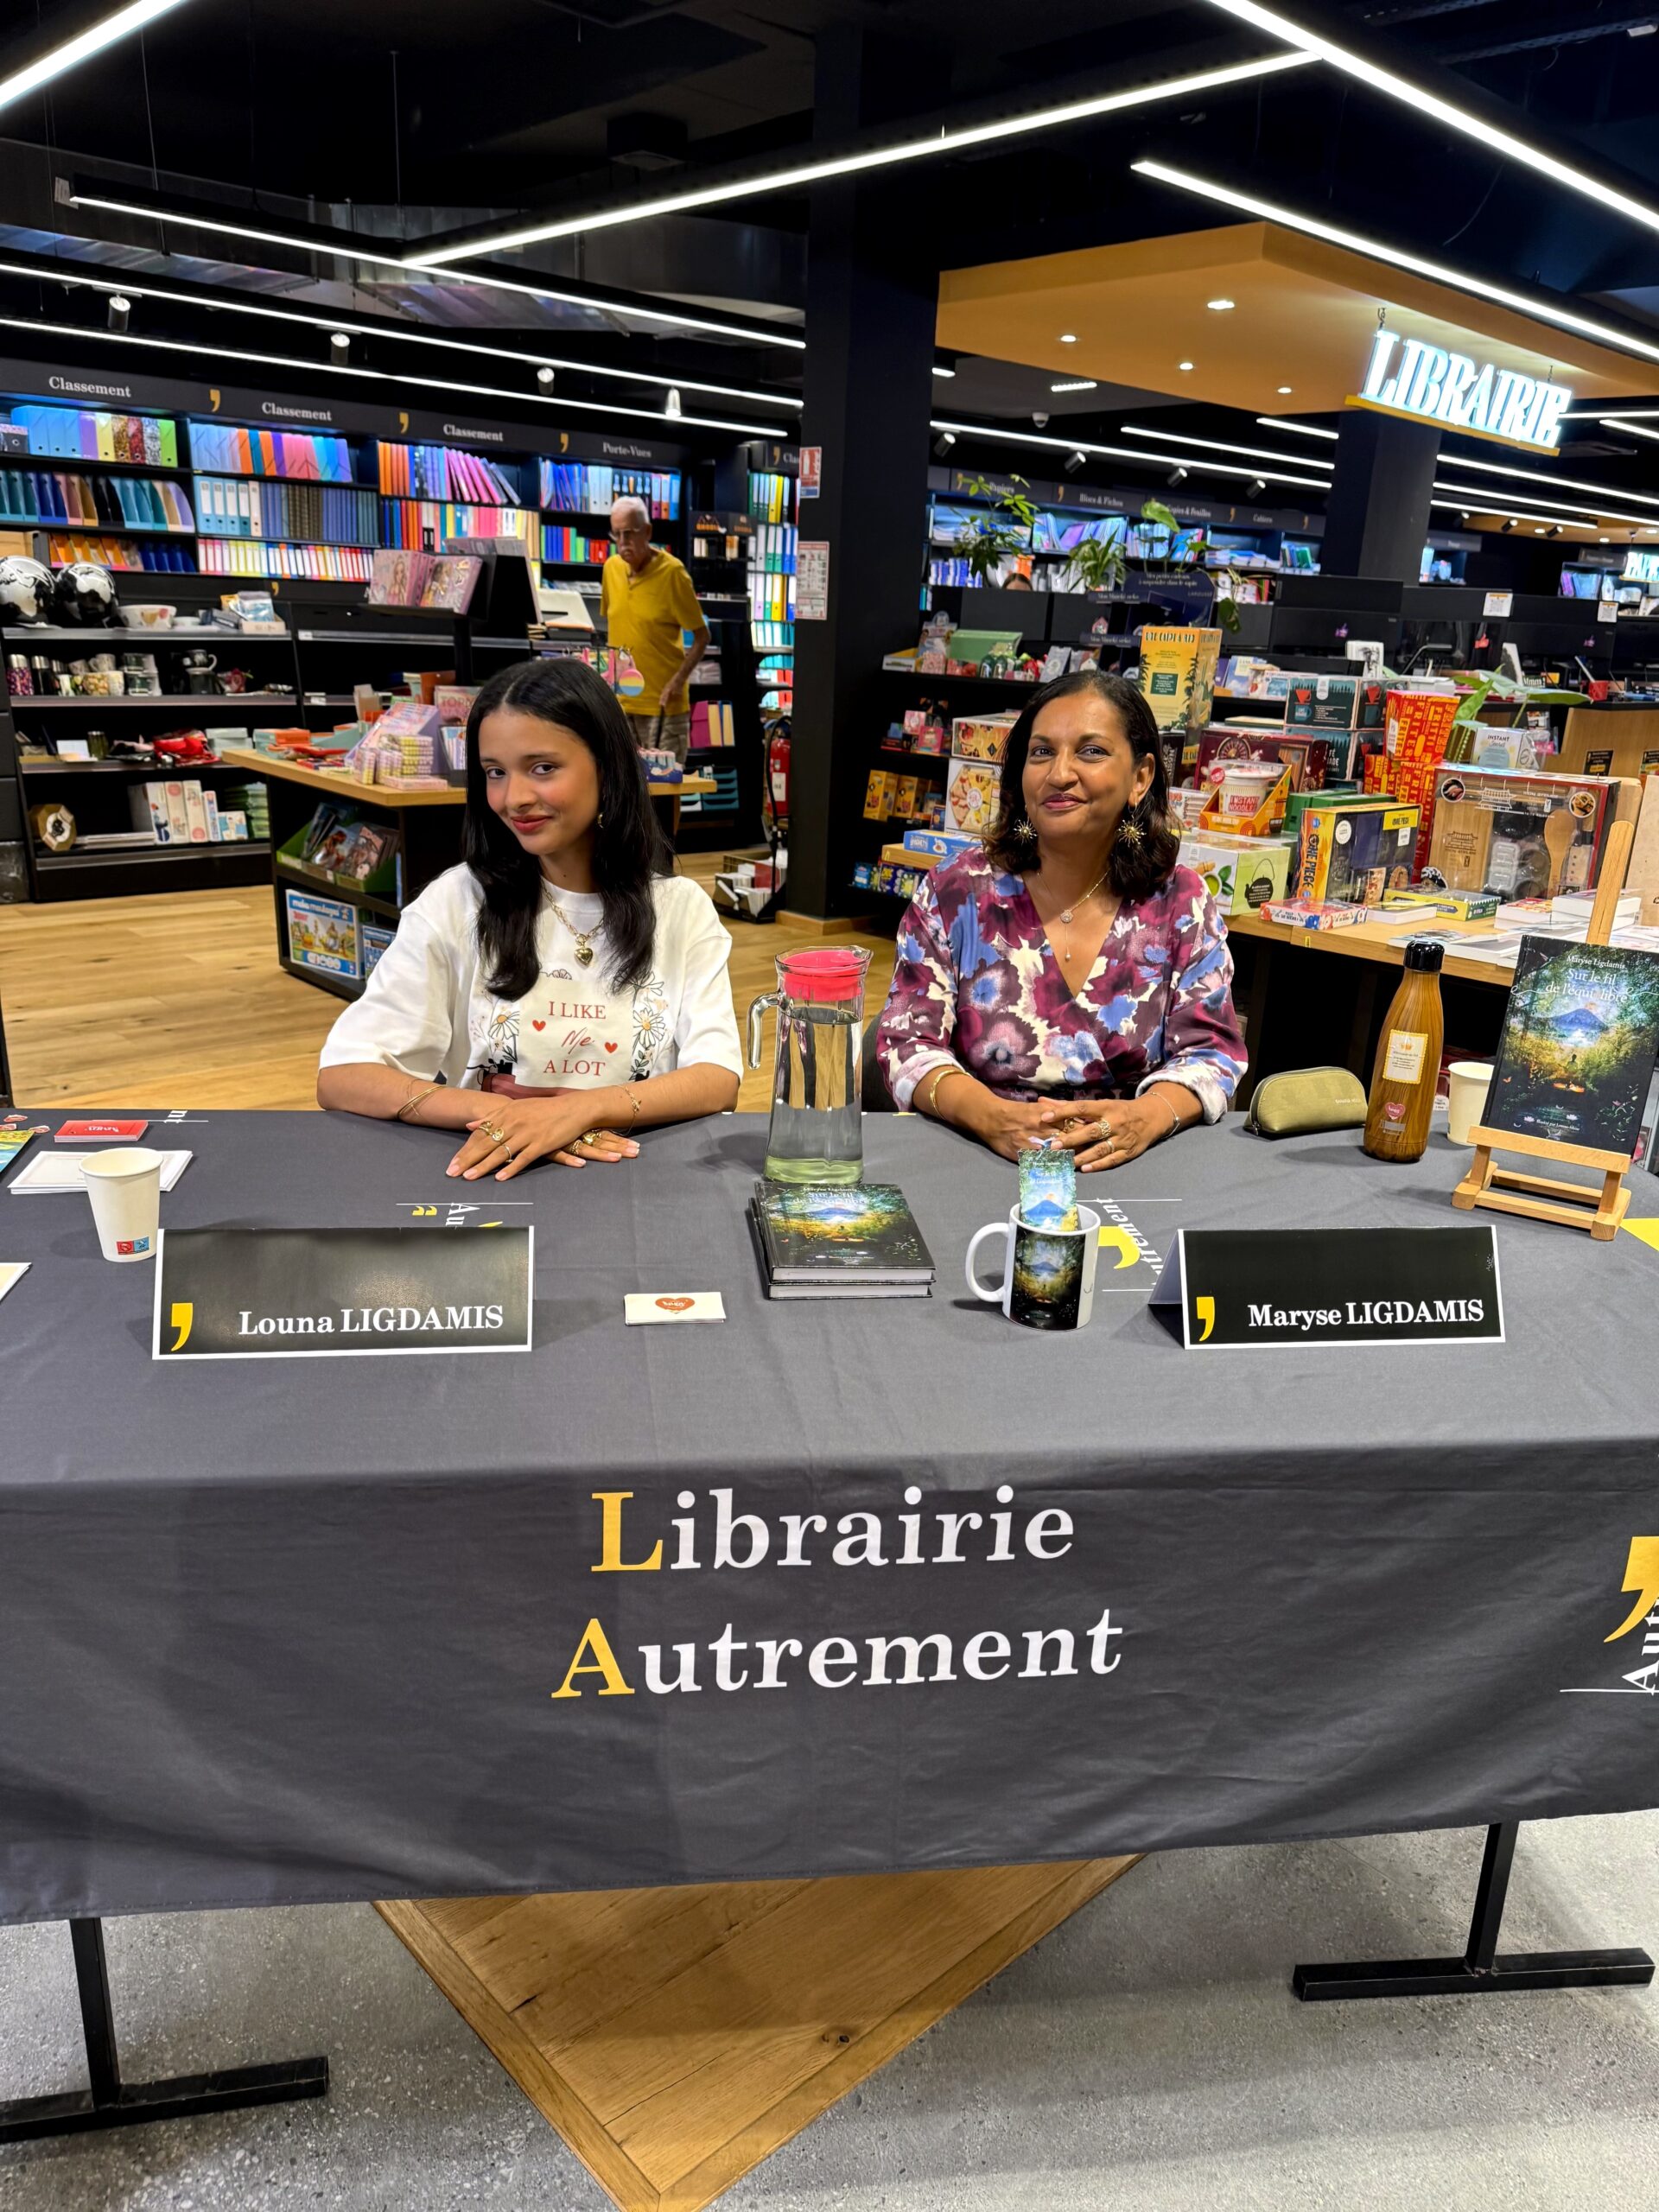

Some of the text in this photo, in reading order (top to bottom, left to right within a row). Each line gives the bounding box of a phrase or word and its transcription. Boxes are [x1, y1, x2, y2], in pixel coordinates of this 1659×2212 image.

[48, 376, 131, 397] Classement
[1357, 330, 1572, 448] LIBRAIRIE
[261, 402, 332, 422] Classement
[443, 423, 504, 442] Classement
[602, 442, 652, 458] Porte-Vues
[1567, 956, 1625, 969] Maryse Ligdamis
[1567, 968, 1617, 987] Sur le fil
[1546, 982, 1560, 993] de
[1600, 988, 1627, 1002] libre
[549, 1001, 607, 1020] I LIKE
[561, 1027, 594, 1054] Me
[543, 1059, 606, 1076] A LOT
[238, 1305, 504, 1336] Louna LIGDAMIS
[1248, 1300, 1484, 1331] Maryse LIGDAMIS
[591, 1484, 1074, 1573] Librairie
[551, 1609, 1123, 1699] Autrement
